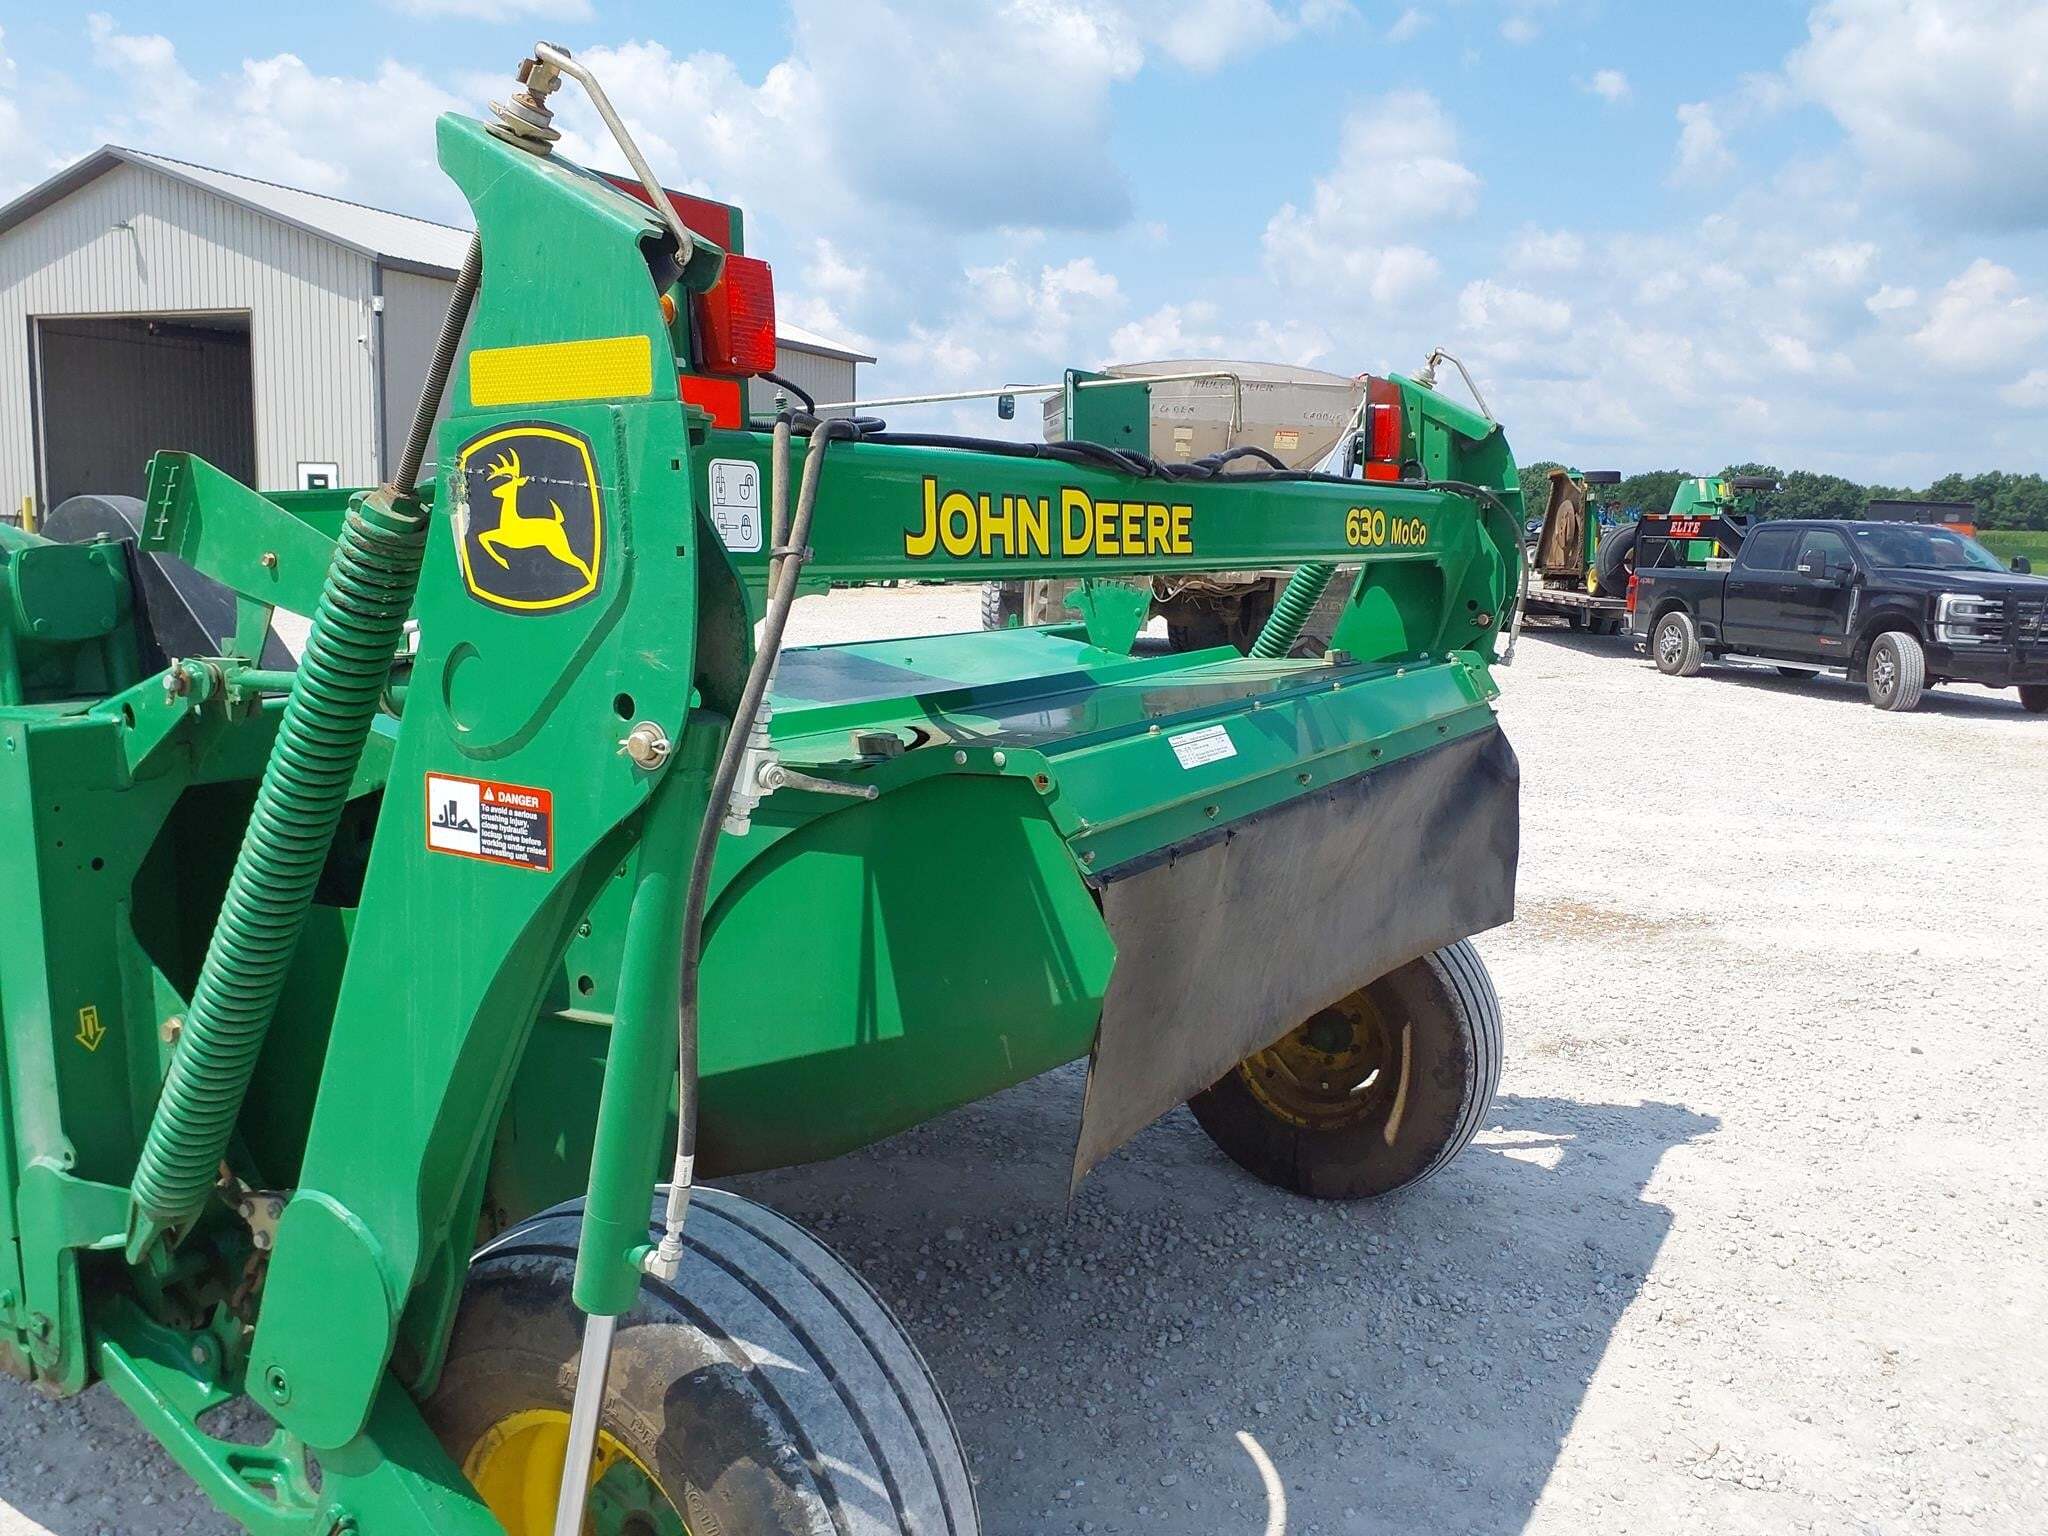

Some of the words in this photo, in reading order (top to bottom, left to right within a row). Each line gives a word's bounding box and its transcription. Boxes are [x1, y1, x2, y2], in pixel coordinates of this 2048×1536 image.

[904, 475, 1050, 558] JOHN
[1060, 486, 1193, 556] DEERE
[1346, 507, 1386, 546] 630
[1391, 517, 1427, 545] MoCo
[1670, 522, 1700, 533] ELITE
[498, 792, 539, 808] DANGER
[481, 814, 508, 825] crushing
[490, 806, 507, 814] avoid
[514, 810, 537, 820] serious
[481, 821, 498, 829] close
[499, 825, 528, 835] hydraulic
[481, 829, 502, 840] lockup
[504, 834, 520, 842] valve
[521, 836, 542, 846] before
[481, 838, 506, 849] working
[508, 843, 525, 852] under
[527, 846, 546, 856] raised
[481, 846, 514, 859] harvesting
